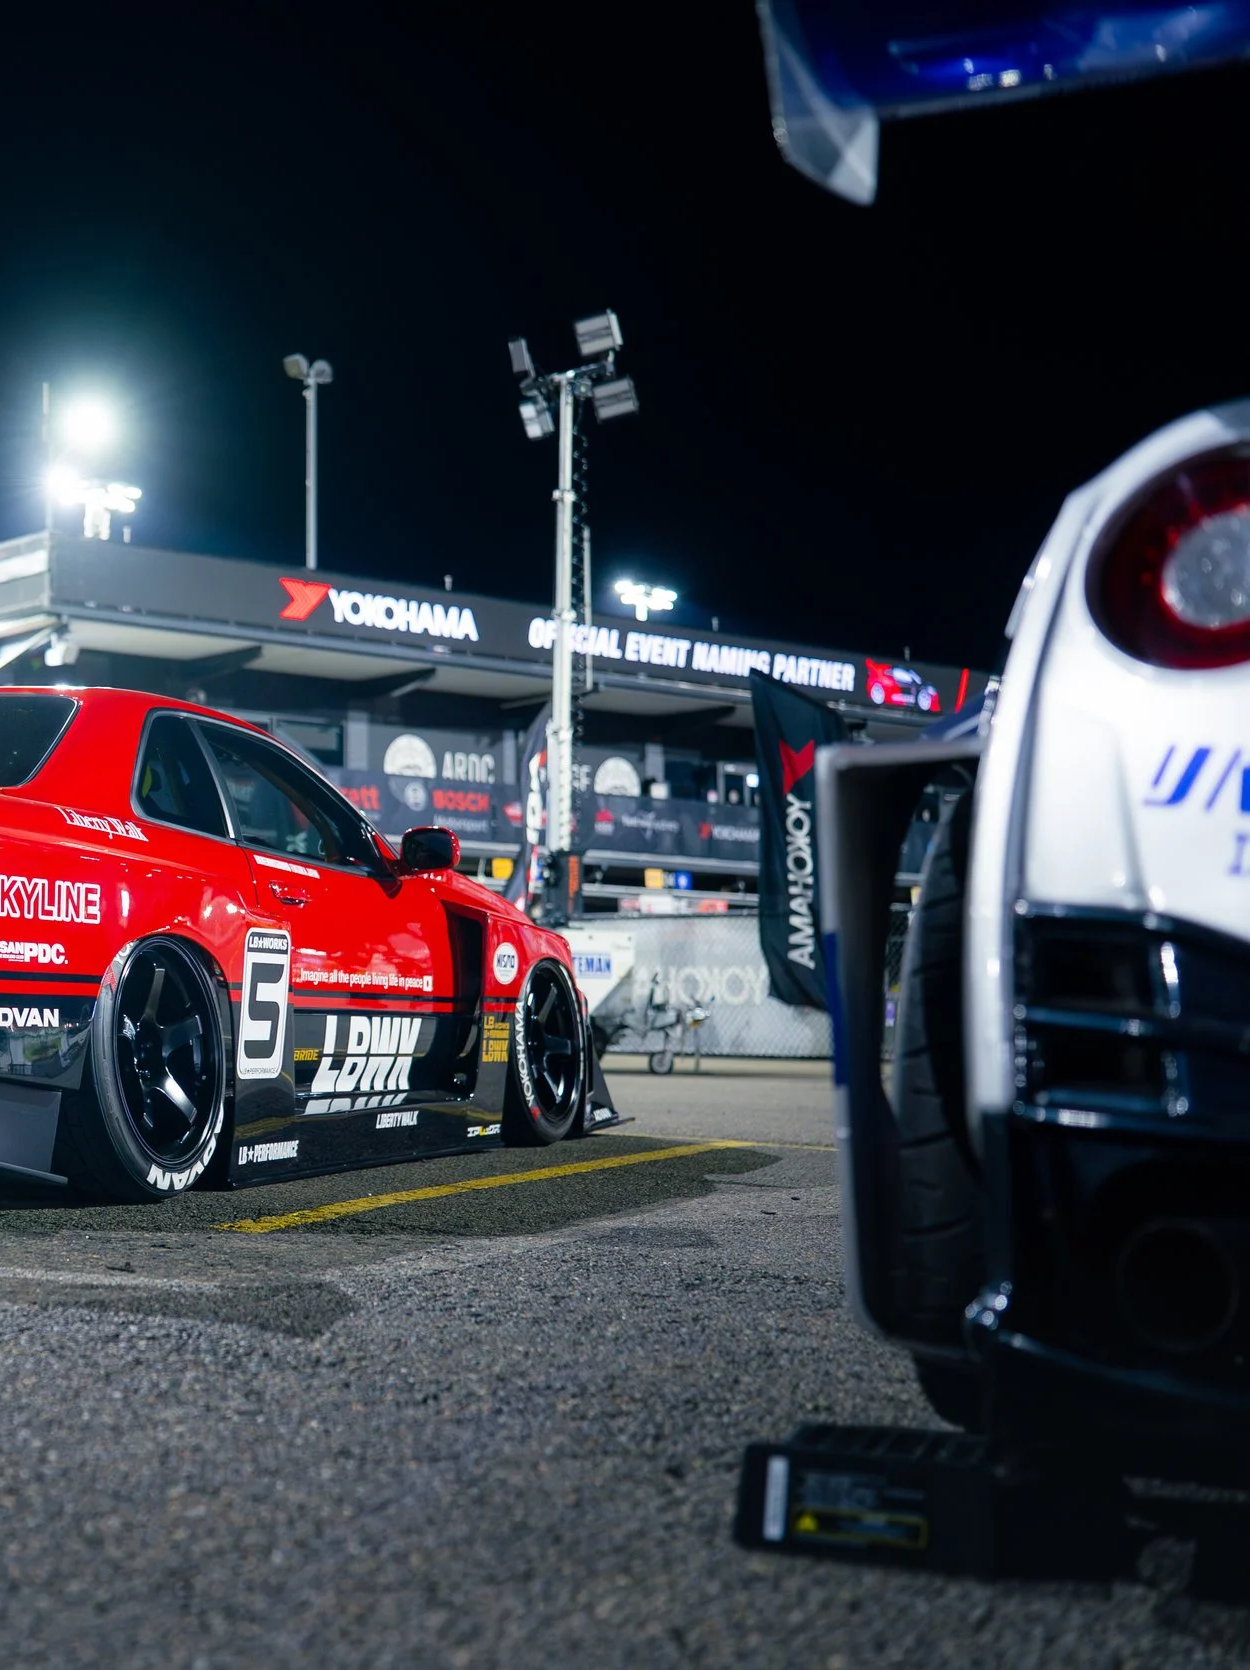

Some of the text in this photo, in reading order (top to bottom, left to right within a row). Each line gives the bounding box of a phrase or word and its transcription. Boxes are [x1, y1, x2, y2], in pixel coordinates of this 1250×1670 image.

[328, 588, 479, 641] YOKOHAMA
[625, 631, 691, 668] EVENT
[692, 641, 770, 677] NAMING
[772, 653, 855, 692] PARTNER
[54, 806, 149, 842] Liberty Walk
[433, 788, 490, 812] BOSCH
[300, 968, 423, 990] Imagine all the people living life in peace
[243, 962, 285, 1059] 5
[305, 1015, 423, 1113] LBWK
[514, 1001, 534, 1108] YOKOHAMA
[253, 1139, 299, 1162] PERFORMANCE
